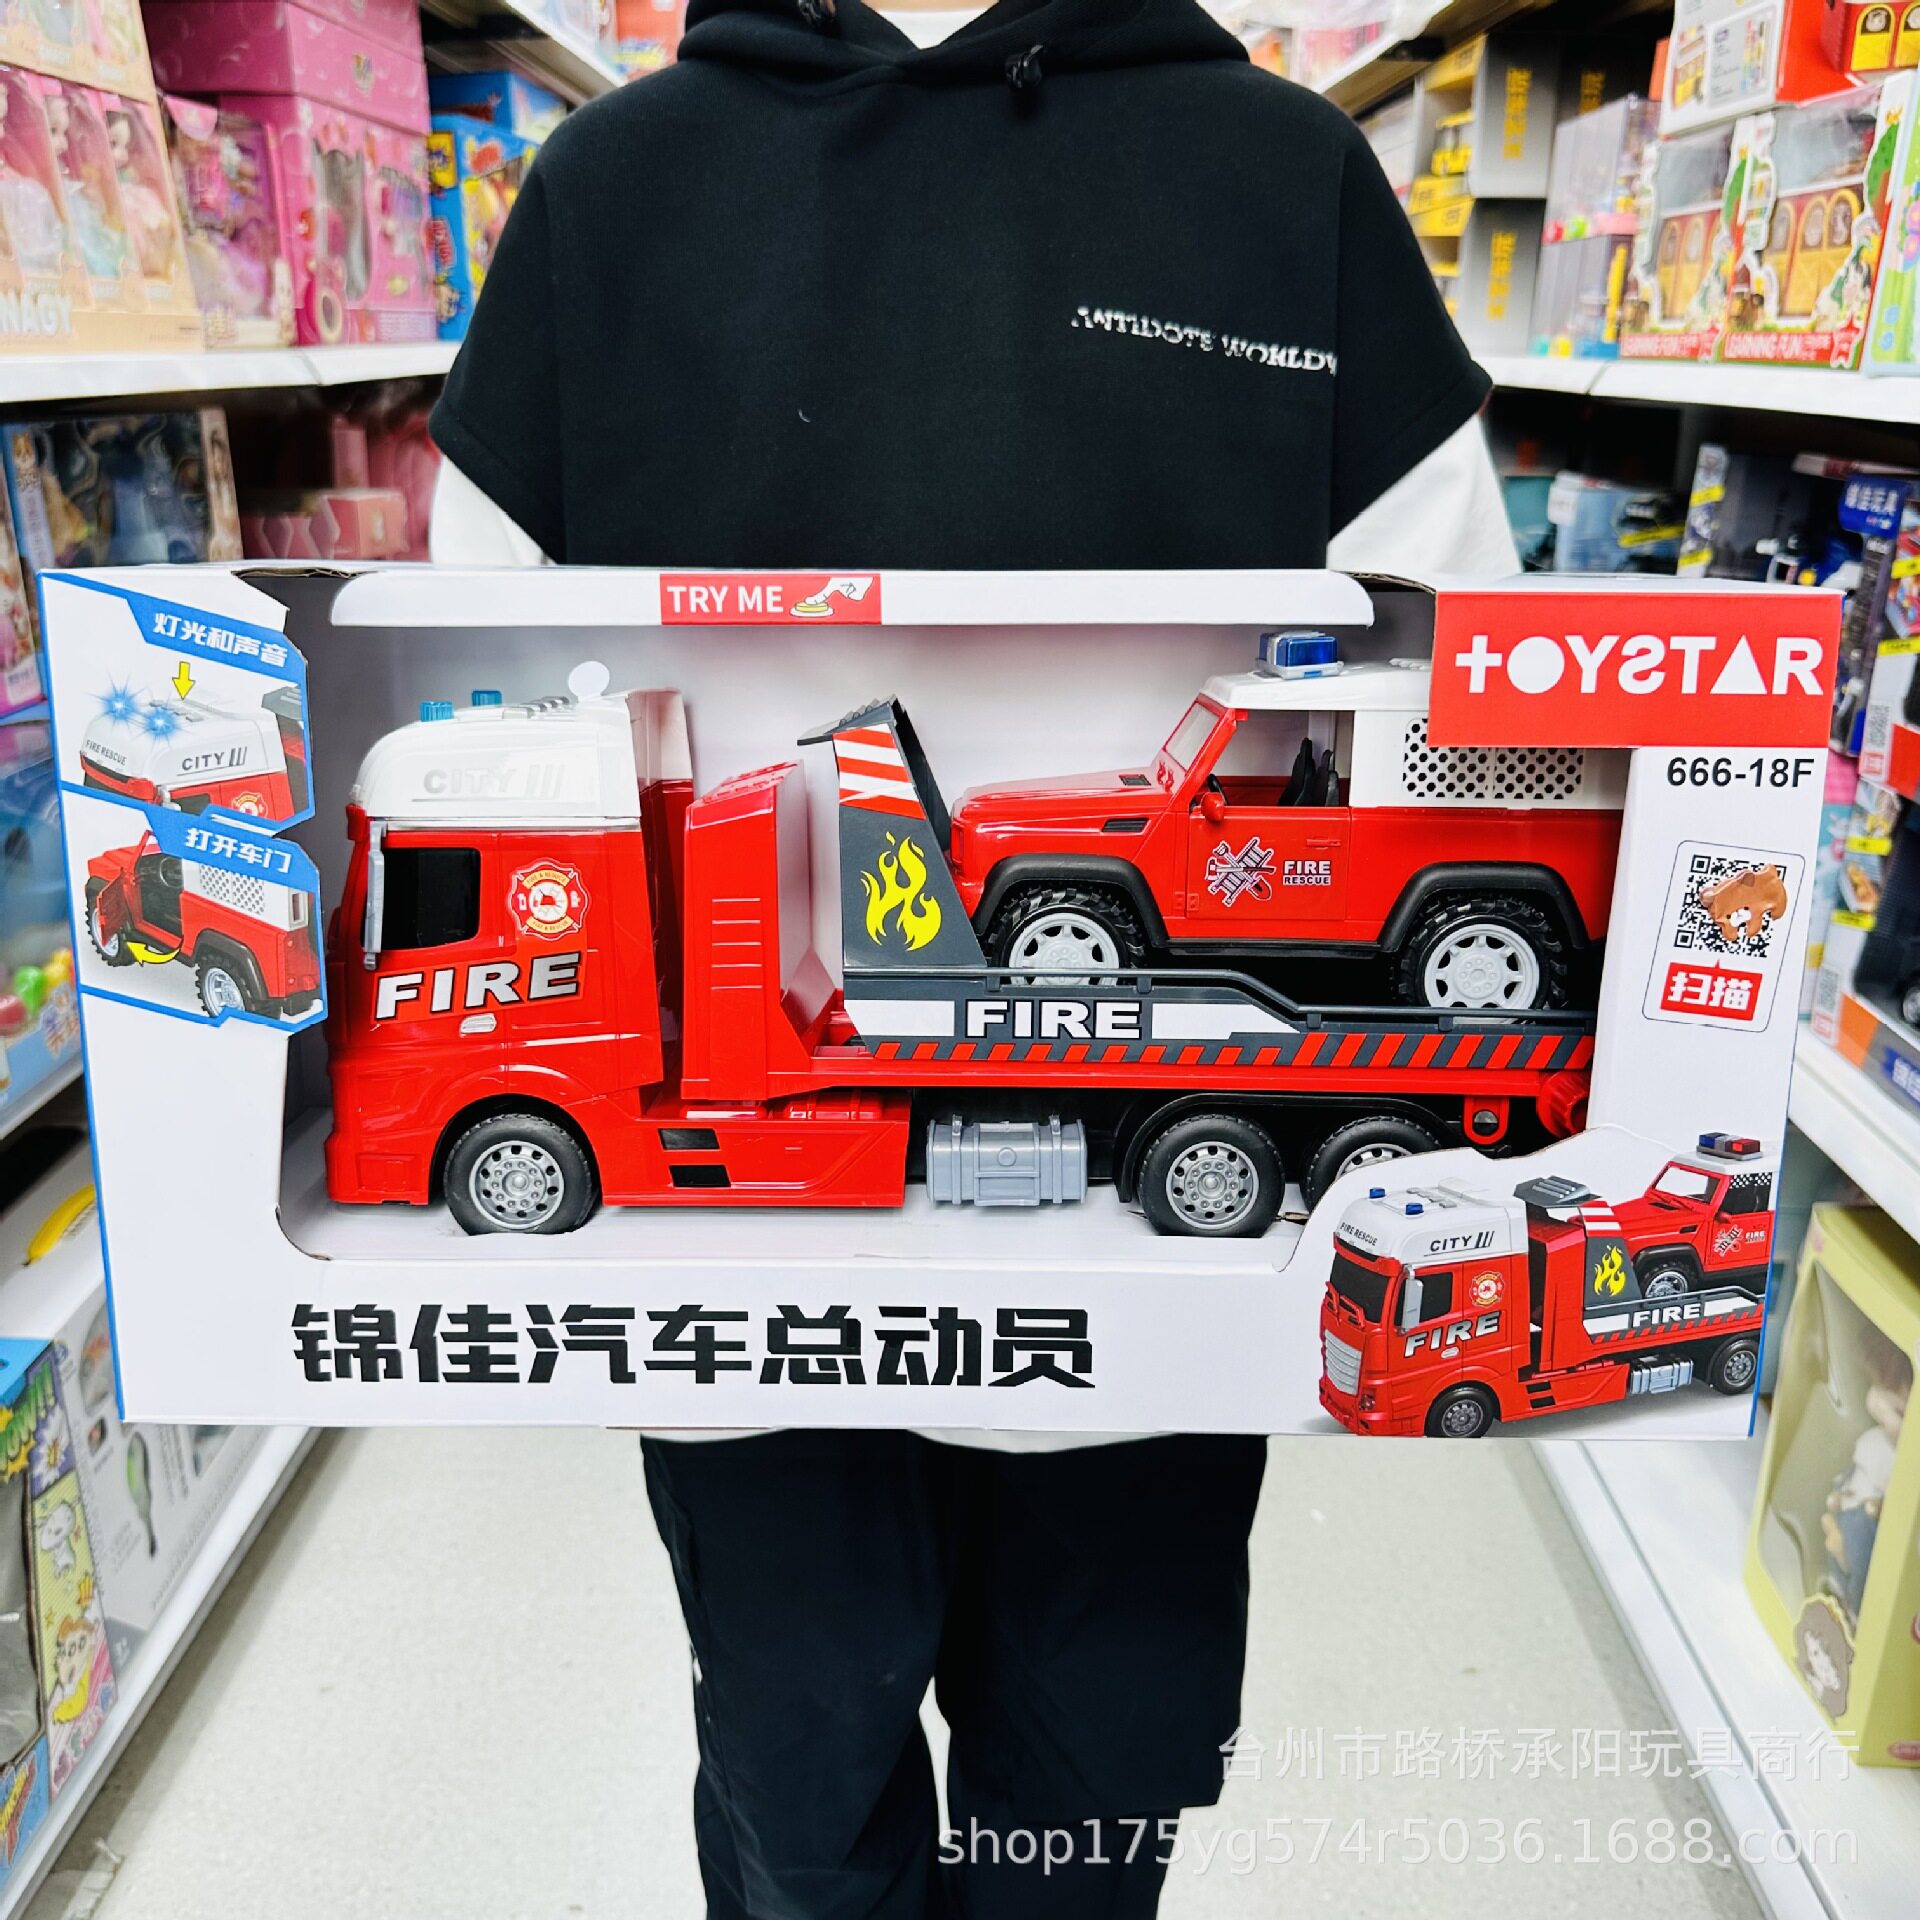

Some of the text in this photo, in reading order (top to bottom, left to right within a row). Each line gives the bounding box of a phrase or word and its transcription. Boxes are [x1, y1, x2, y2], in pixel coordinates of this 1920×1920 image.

[667, 585, 784, 613] TRY ME
[153, 612, 288, 668] 灯光和声音
[181, 751, 225, 771] CITY
[1666, 756, 1815, 788] 666-18F
[423, 767, 516, 795] CITY
[184, 827, 292, 874] 打开车门
[1283, 860, 1332, 875] FIRE
[1284, 876, 1331, 885] RESCUE
[374, 950, 583, 1021] FIRE
[1667, 971, 1753, 1011] 扫描
[965, 1000, 1142, 1040] FIRE
[1429, 1235, 1473, 1252] CITY
[1632, 1303, 1700, 1328] FIRE
[291, 1303, 1096, 1389] 锦佳汽车总动员
[1403, 1311, 1502, 1359] FIRE
